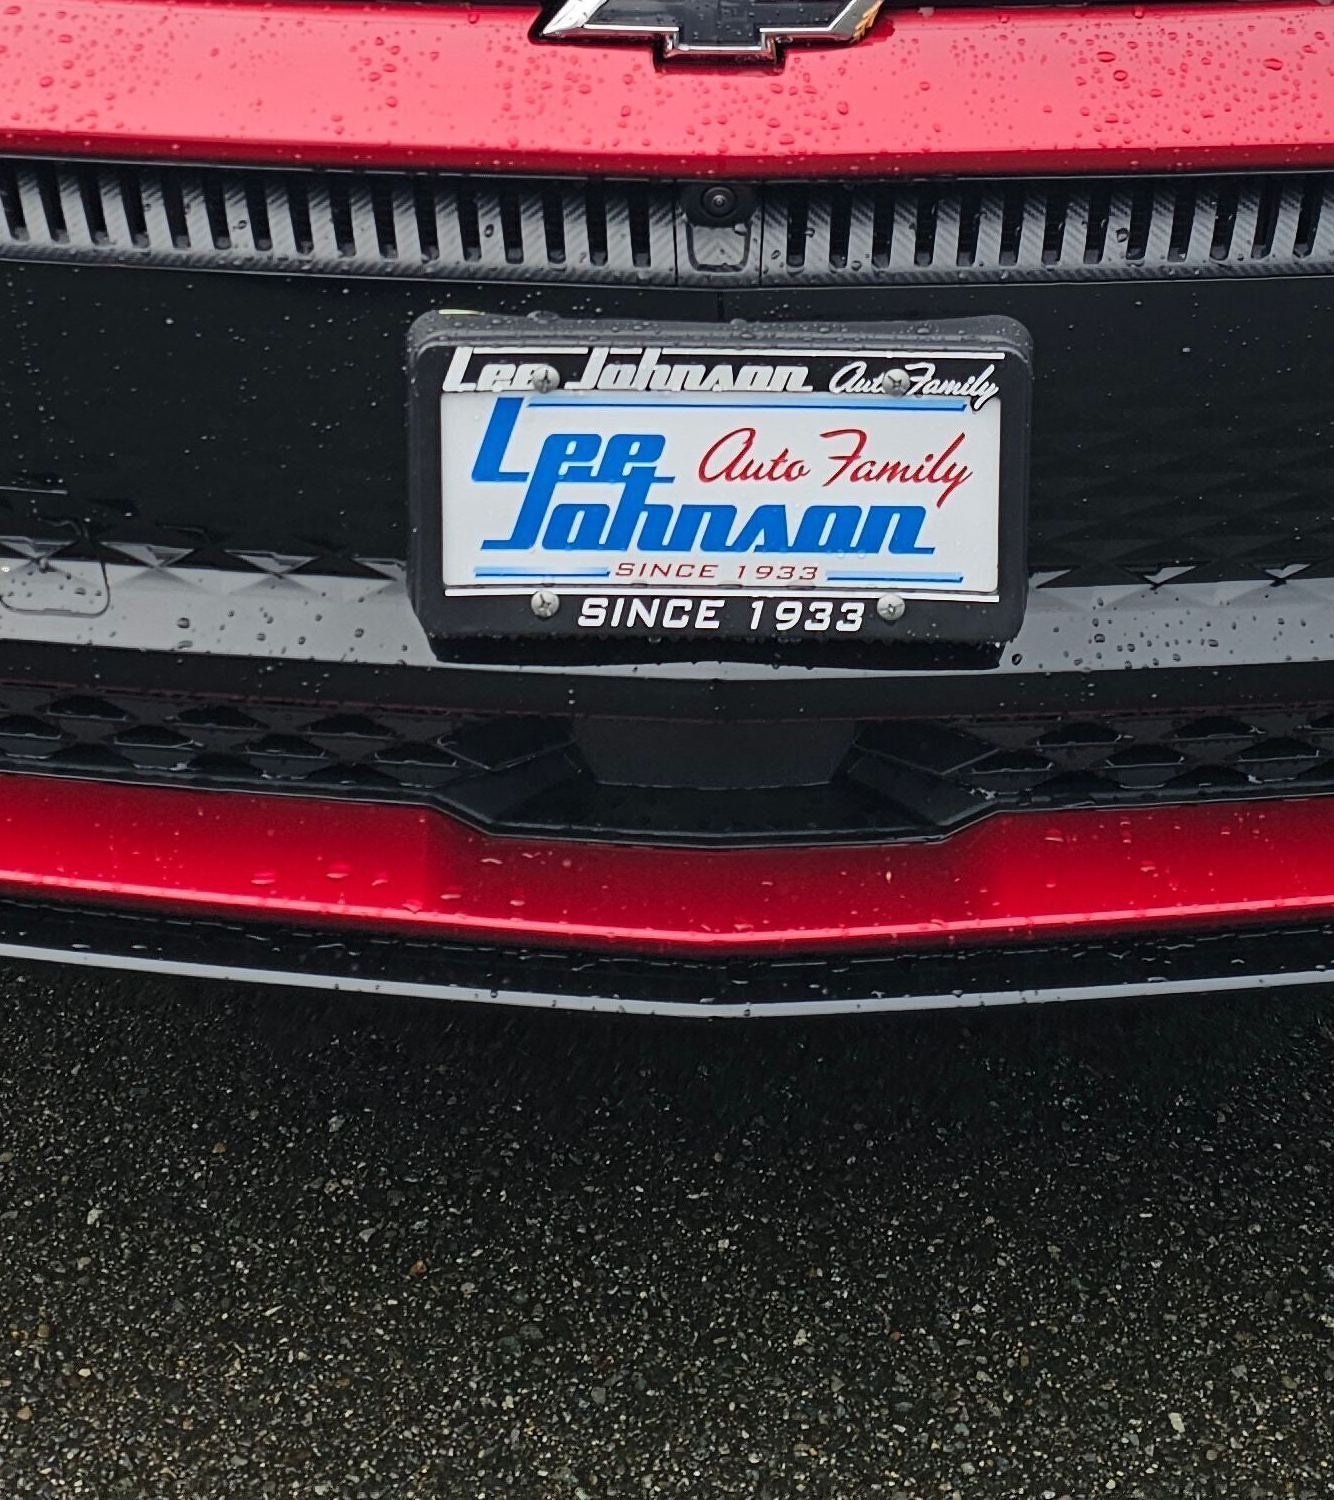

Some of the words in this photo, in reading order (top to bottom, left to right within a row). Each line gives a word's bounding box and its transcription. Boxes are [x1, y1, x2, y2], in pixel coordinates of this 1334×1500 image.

[564, 346, 814, 392] Johnson
[828, 360, 903, 395] Aut
[904, 361, 1000, 410] Family
[471, 397, 676, 483] Lee
[697, 427, 811, 484] Auto
[819, 428, 974, 509] Family
[480, 474, 936, 555] Johnson
[614, 562, 719, 580] SINCE
[737, 564, 819, 581] 1933
[577, 597, 727, 630] SINCE
[750, 599, 866, 633] 1933
